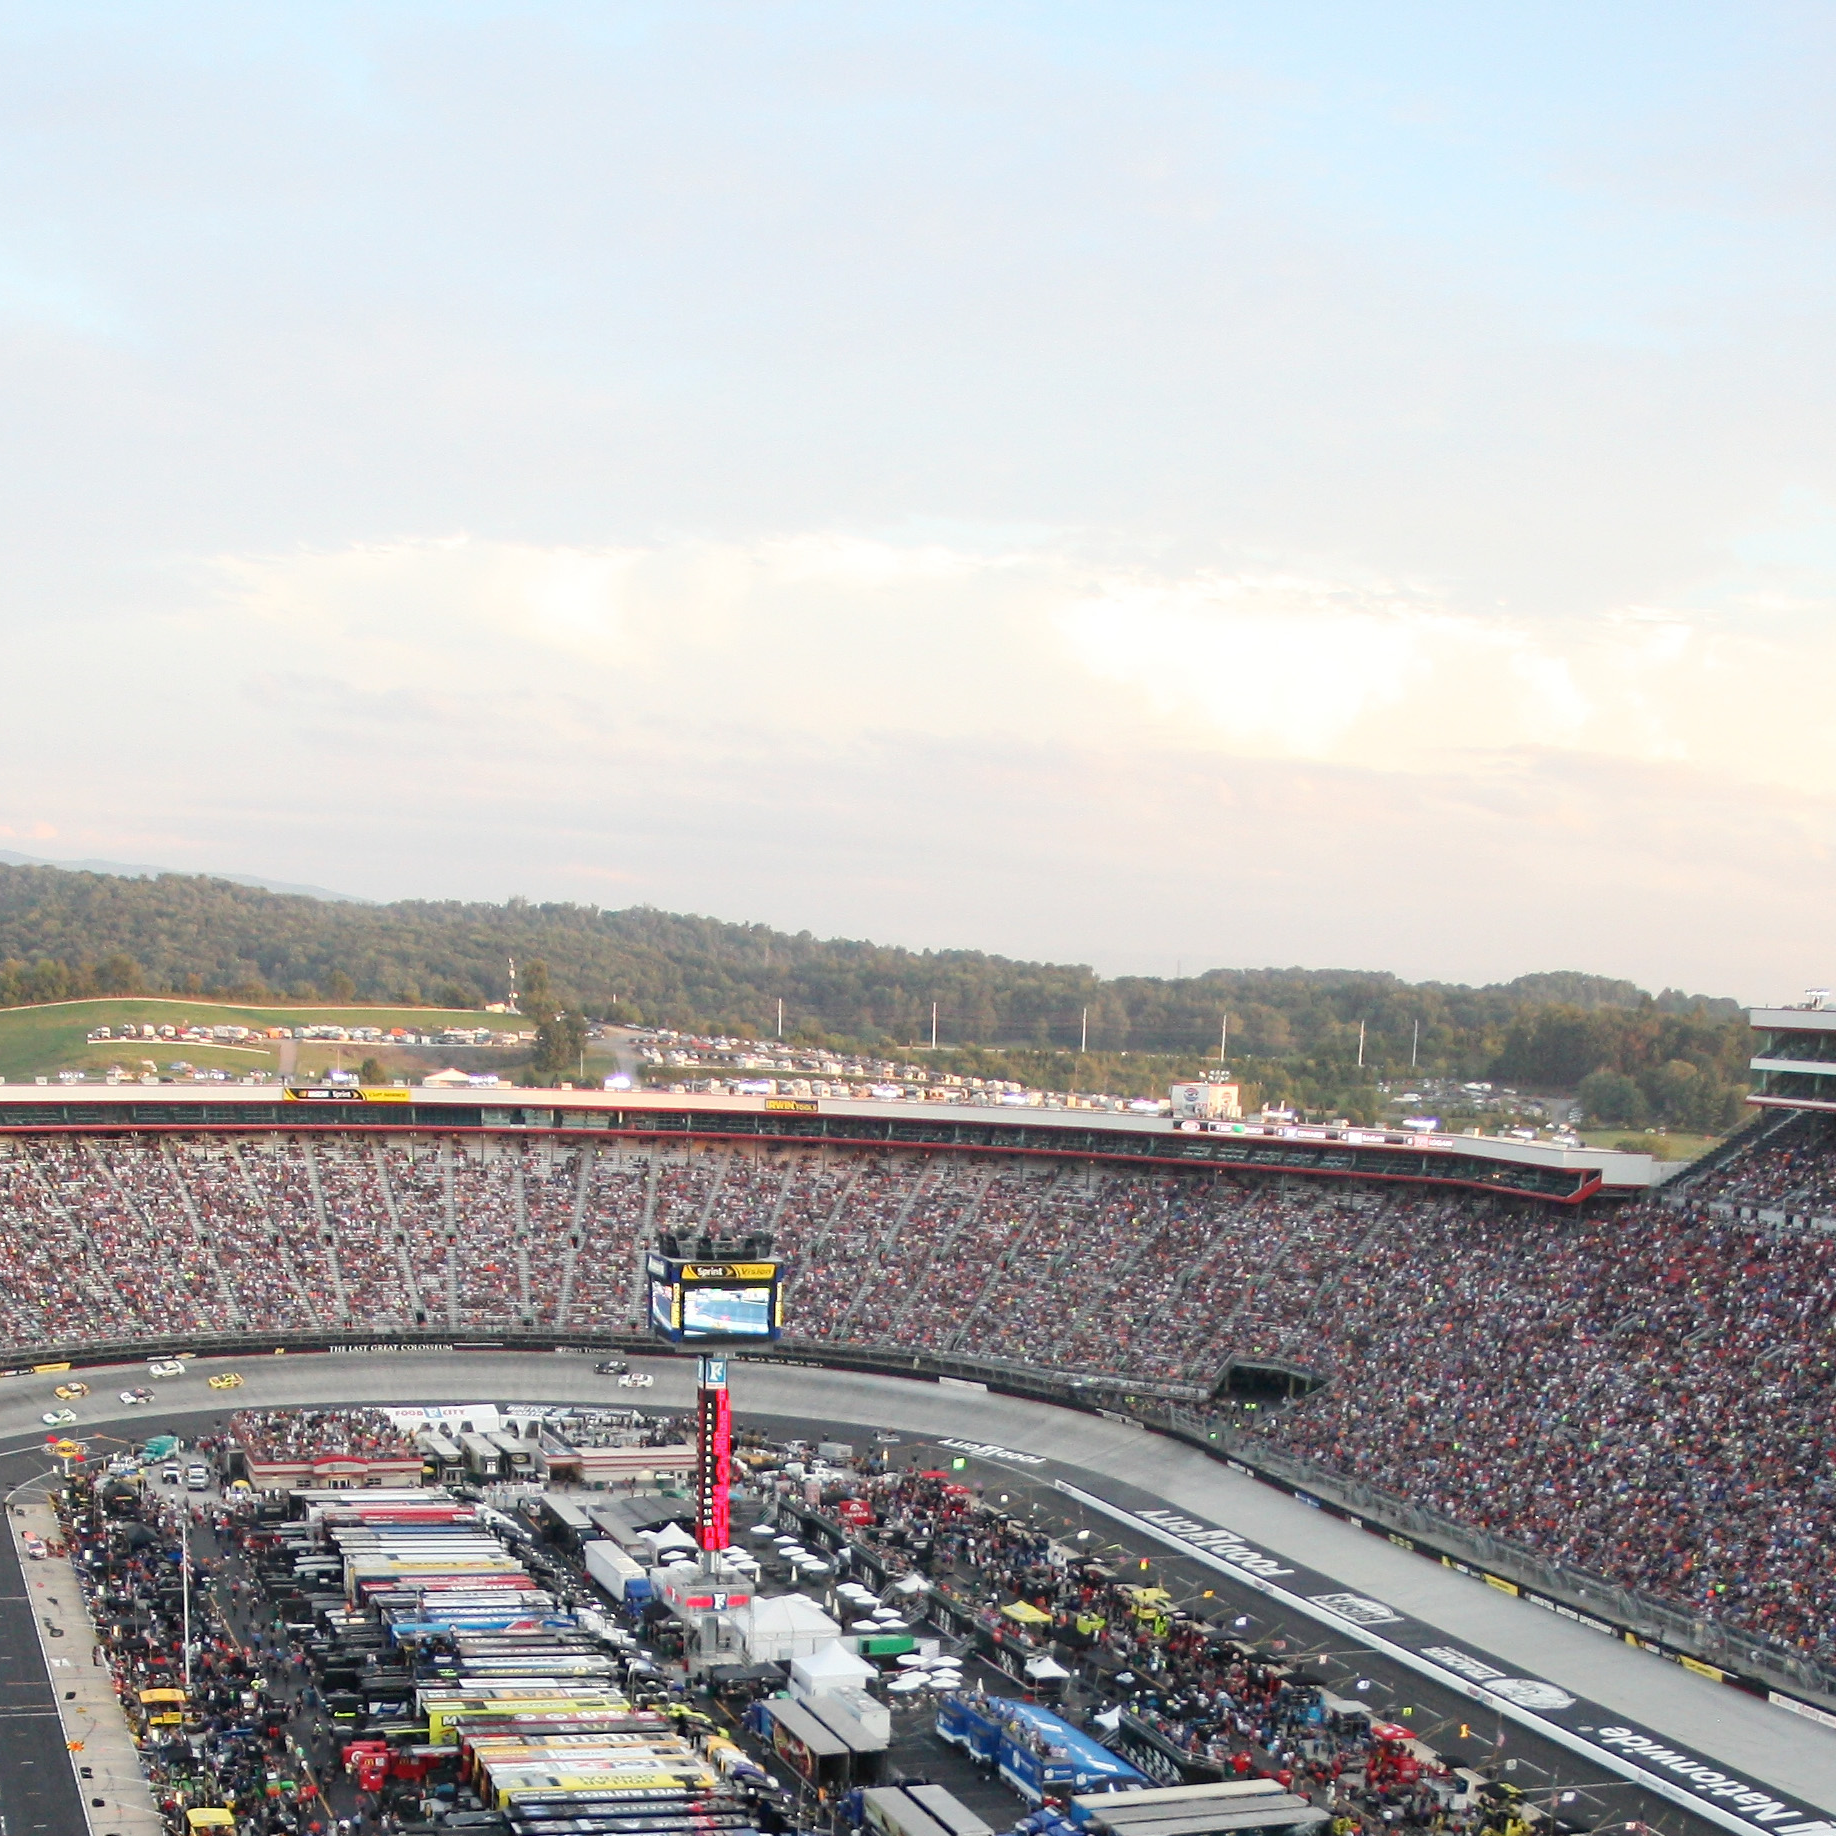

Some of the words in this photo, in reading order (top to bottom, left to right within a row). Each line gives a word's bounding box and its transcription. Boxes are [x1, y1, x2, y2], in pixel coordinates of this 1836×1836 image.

[697, 1267, 723, 1277] Sprint
[400, 1343, 453, 1351] COLOSSEUM
[395, 1409, 424, 1417] FOOD
[442, 1408, 466, 1416] CITY
[937, 1438, 979, 1450] CITY
[998, 1450, 1046, 1464] FOOD
[1134, 1509, 1204, 1540] CITY
[1211, 1543, 1295, 1577] FOOD
[1598, 1726, 1803, 1822] Nationwide
